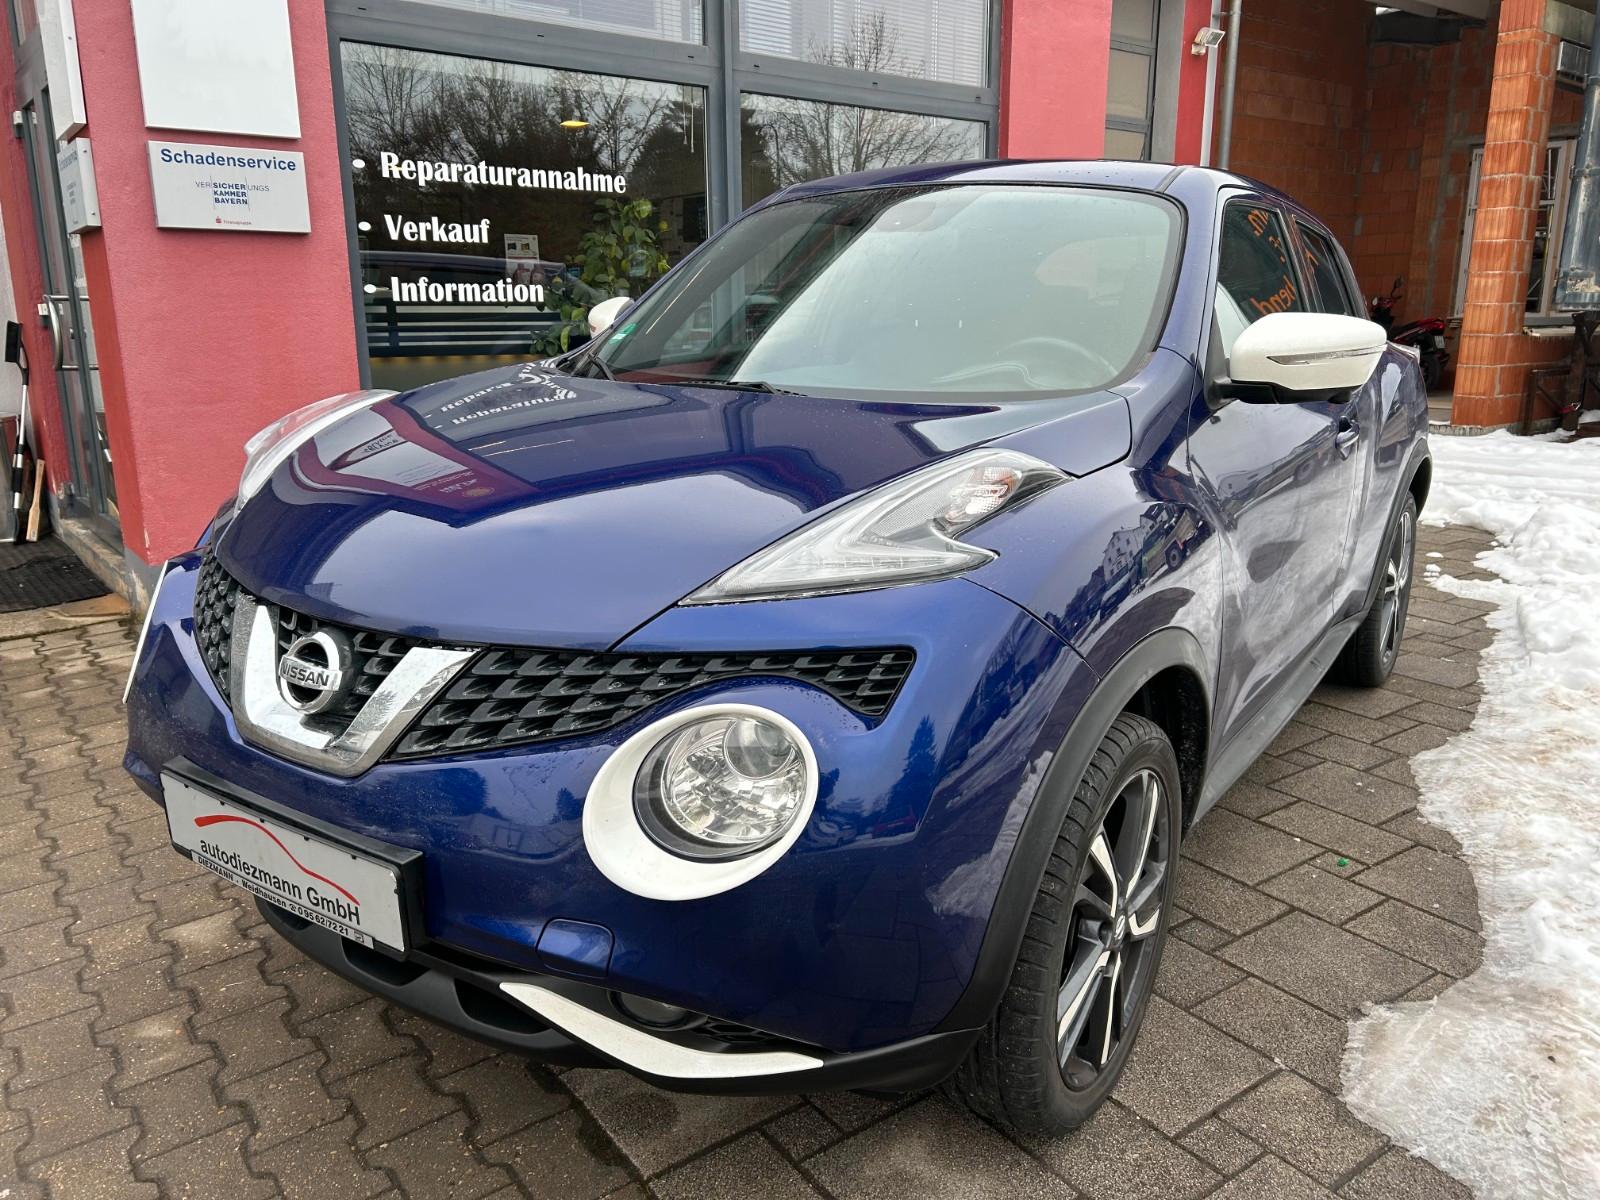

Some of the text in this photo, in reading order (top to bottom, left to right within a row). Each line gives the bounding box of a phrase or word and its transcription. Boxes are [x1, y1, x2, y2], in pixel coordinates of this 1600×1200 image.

[160, 148, 296, 171] Schadenservice
[380, 151, 627, 194] Reparaturannahme
[213, 190, 247, 198] KAMMER
[214, 197, 248, 205] BAYERN
[383, 213, 491, 244] Verkauf
[390, 276, 544, 303] Information
[280, 662, 330, 686] NISSAN
[198, 857, 234, 882] DIEZMANN
[241, 879, 287, 909] Weidhausen
[200, 838, 361, 926] autodiezmann GmbH
